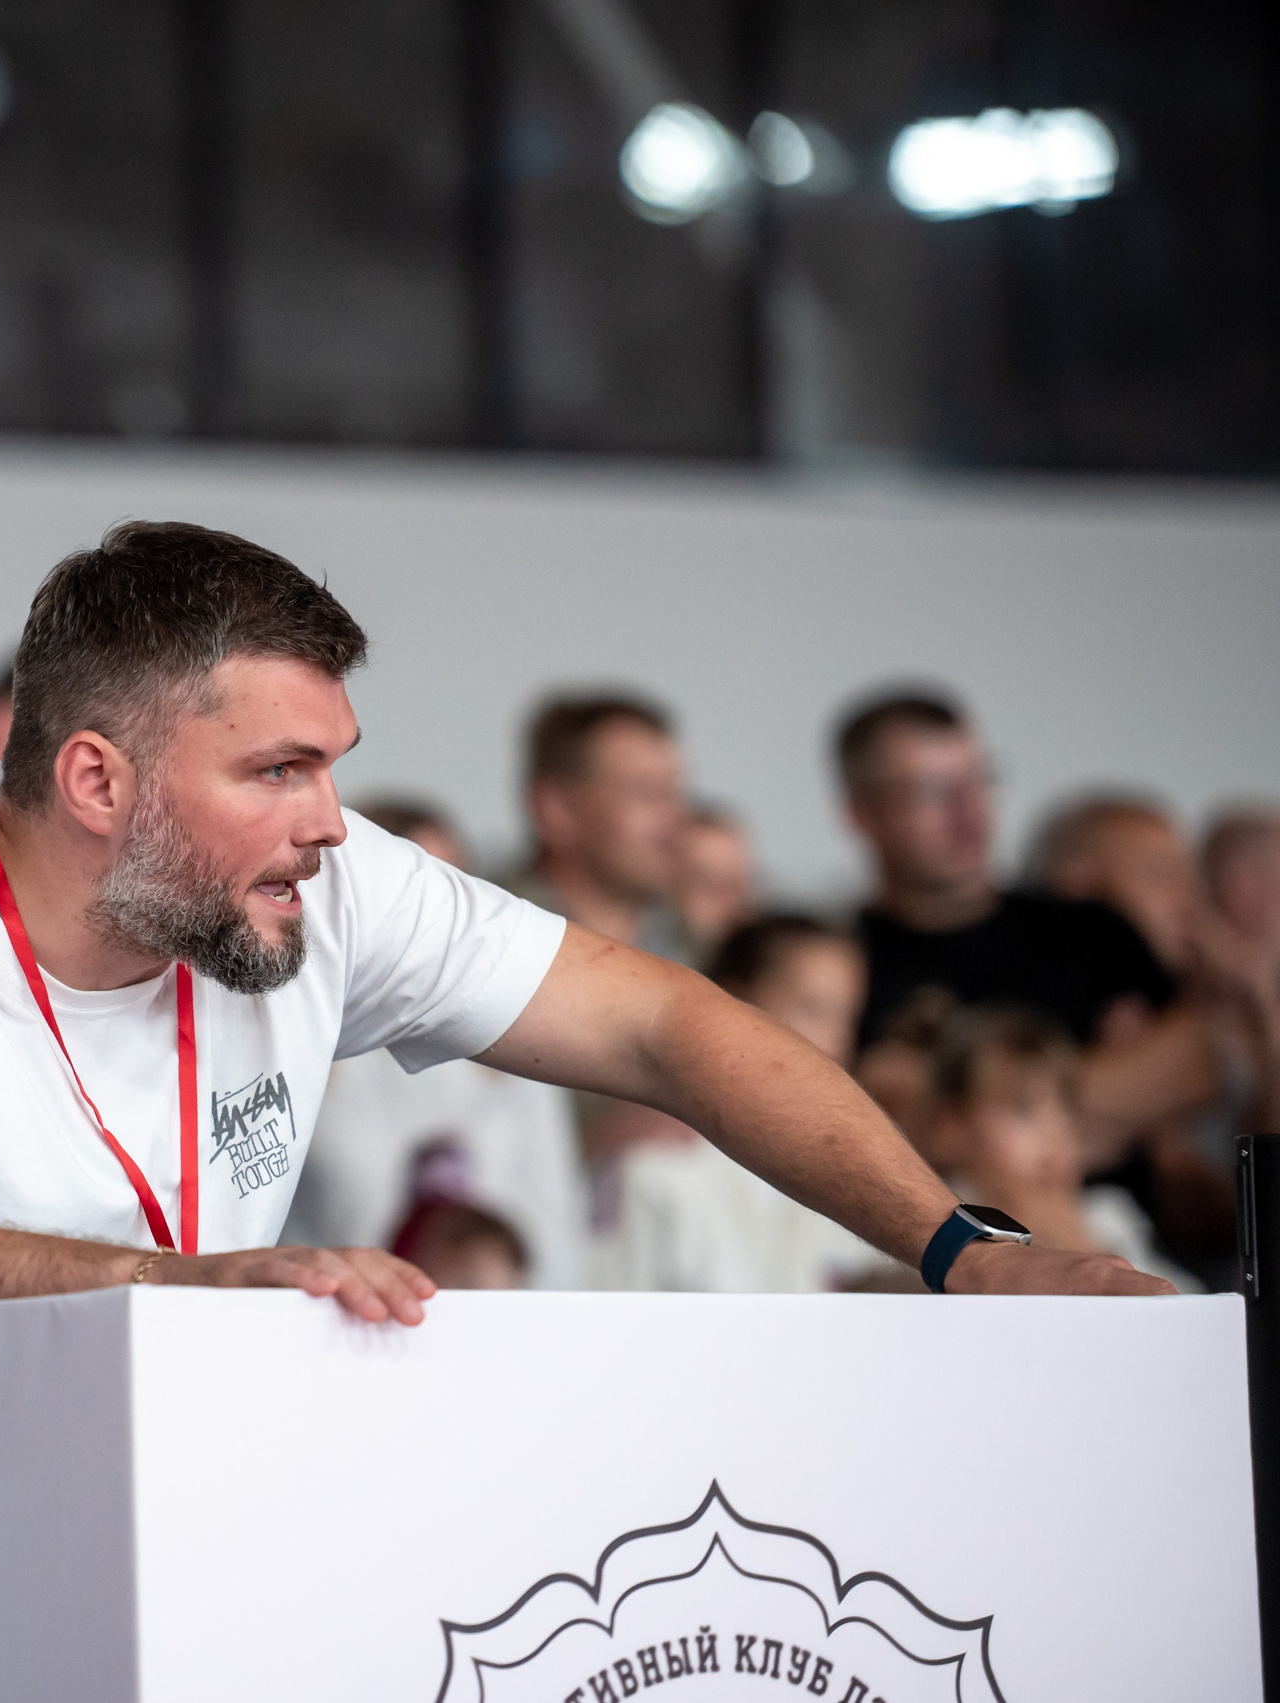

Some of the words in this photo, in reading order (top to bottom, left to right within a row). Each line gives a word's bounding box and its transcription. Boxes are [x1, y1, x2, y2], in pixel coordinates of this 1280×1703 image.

[224, 1118, 283, 1174] BUILT
[231, 1144, 290, 1199] TOUGH
[734, 1634, 834, 1697] КЛУБ
